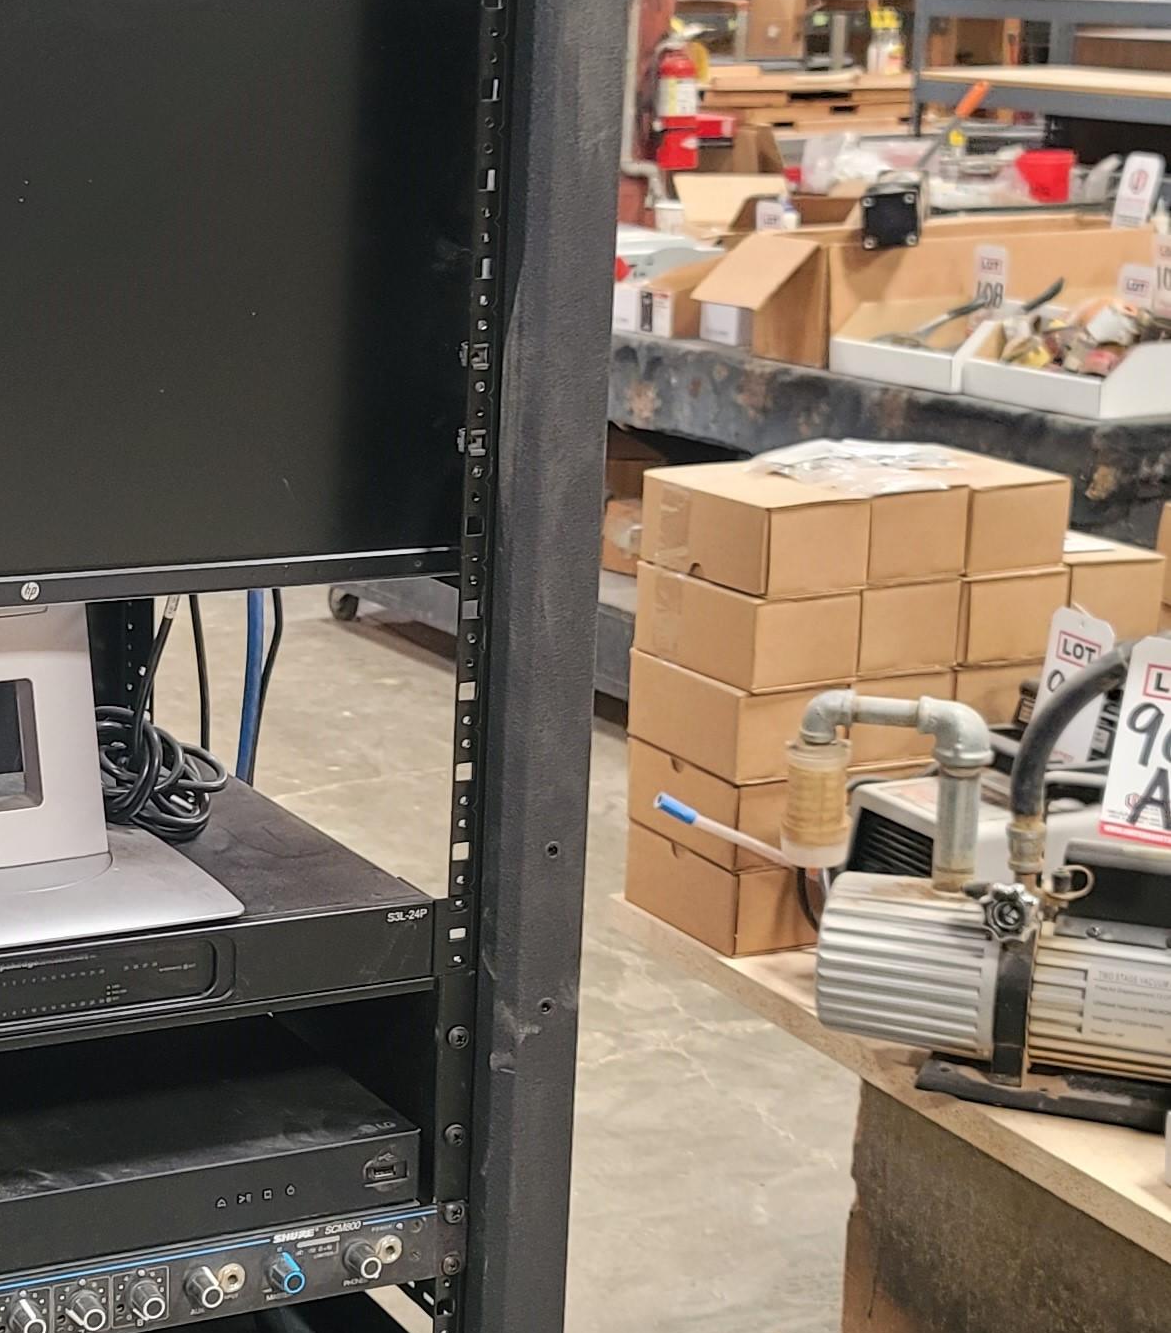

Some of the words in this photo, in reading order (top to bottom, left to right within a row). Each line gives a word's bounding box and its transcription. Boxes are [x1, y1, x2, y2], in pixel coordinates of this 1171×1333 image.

[23, 582, 38, 600] hp
[1062, 638, 1096, 665] LOT
[387, 908, 428, 923] S3L-24P
[273, 1228, 315, 1244] SHURE
[325, 1221, 362, 1235] SCM800
